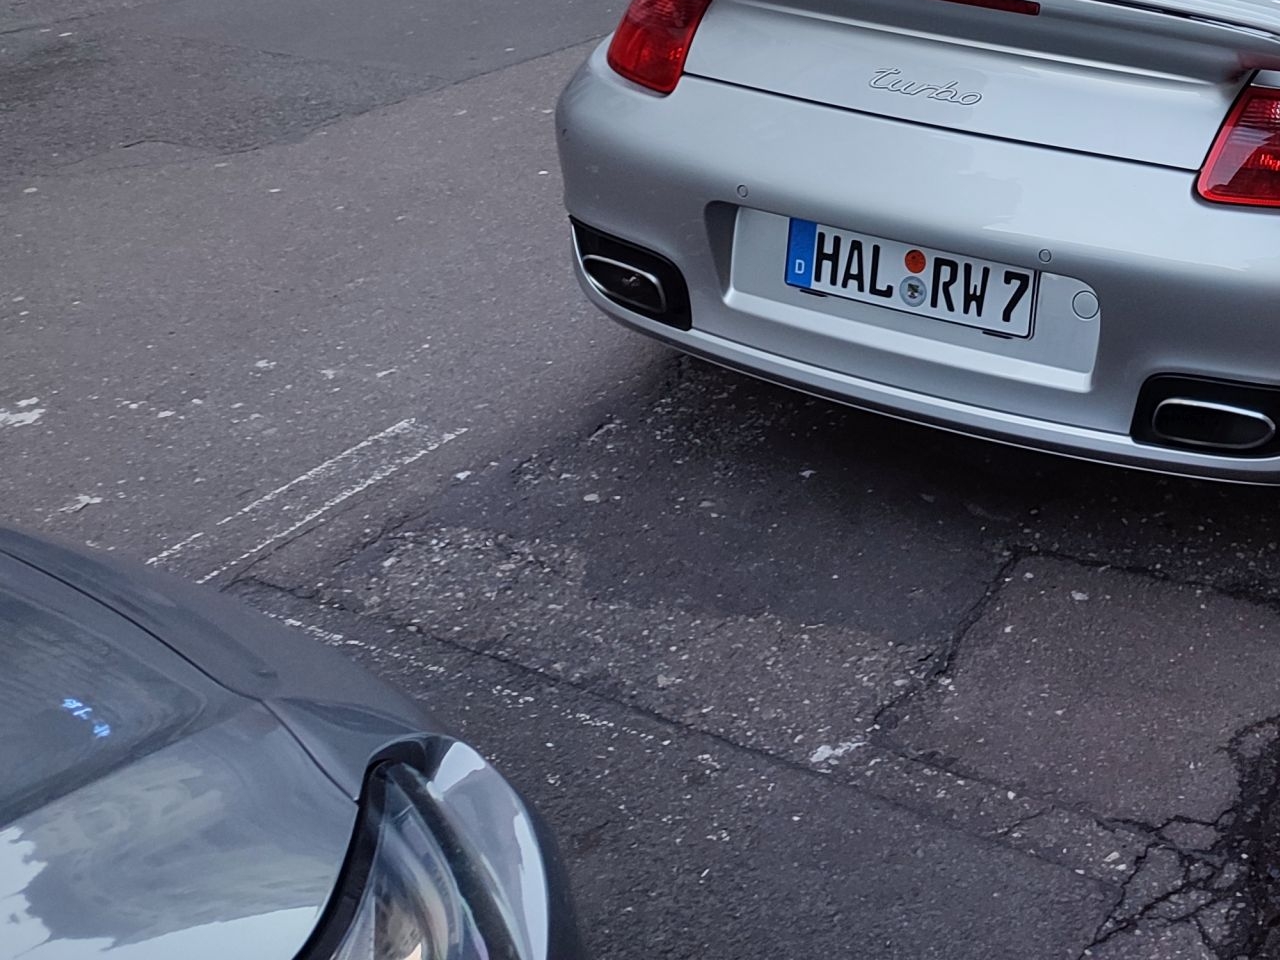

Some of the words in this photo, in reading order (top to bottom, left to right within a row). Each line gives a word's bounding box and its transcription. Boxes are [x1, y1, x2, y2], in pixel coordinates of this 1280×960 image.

[795, 259, 805, 274] D
[814, 231, 894, 299] HAL
[930, 256, 990, 317] RW
[1002, 270, 1030, 323] 7
